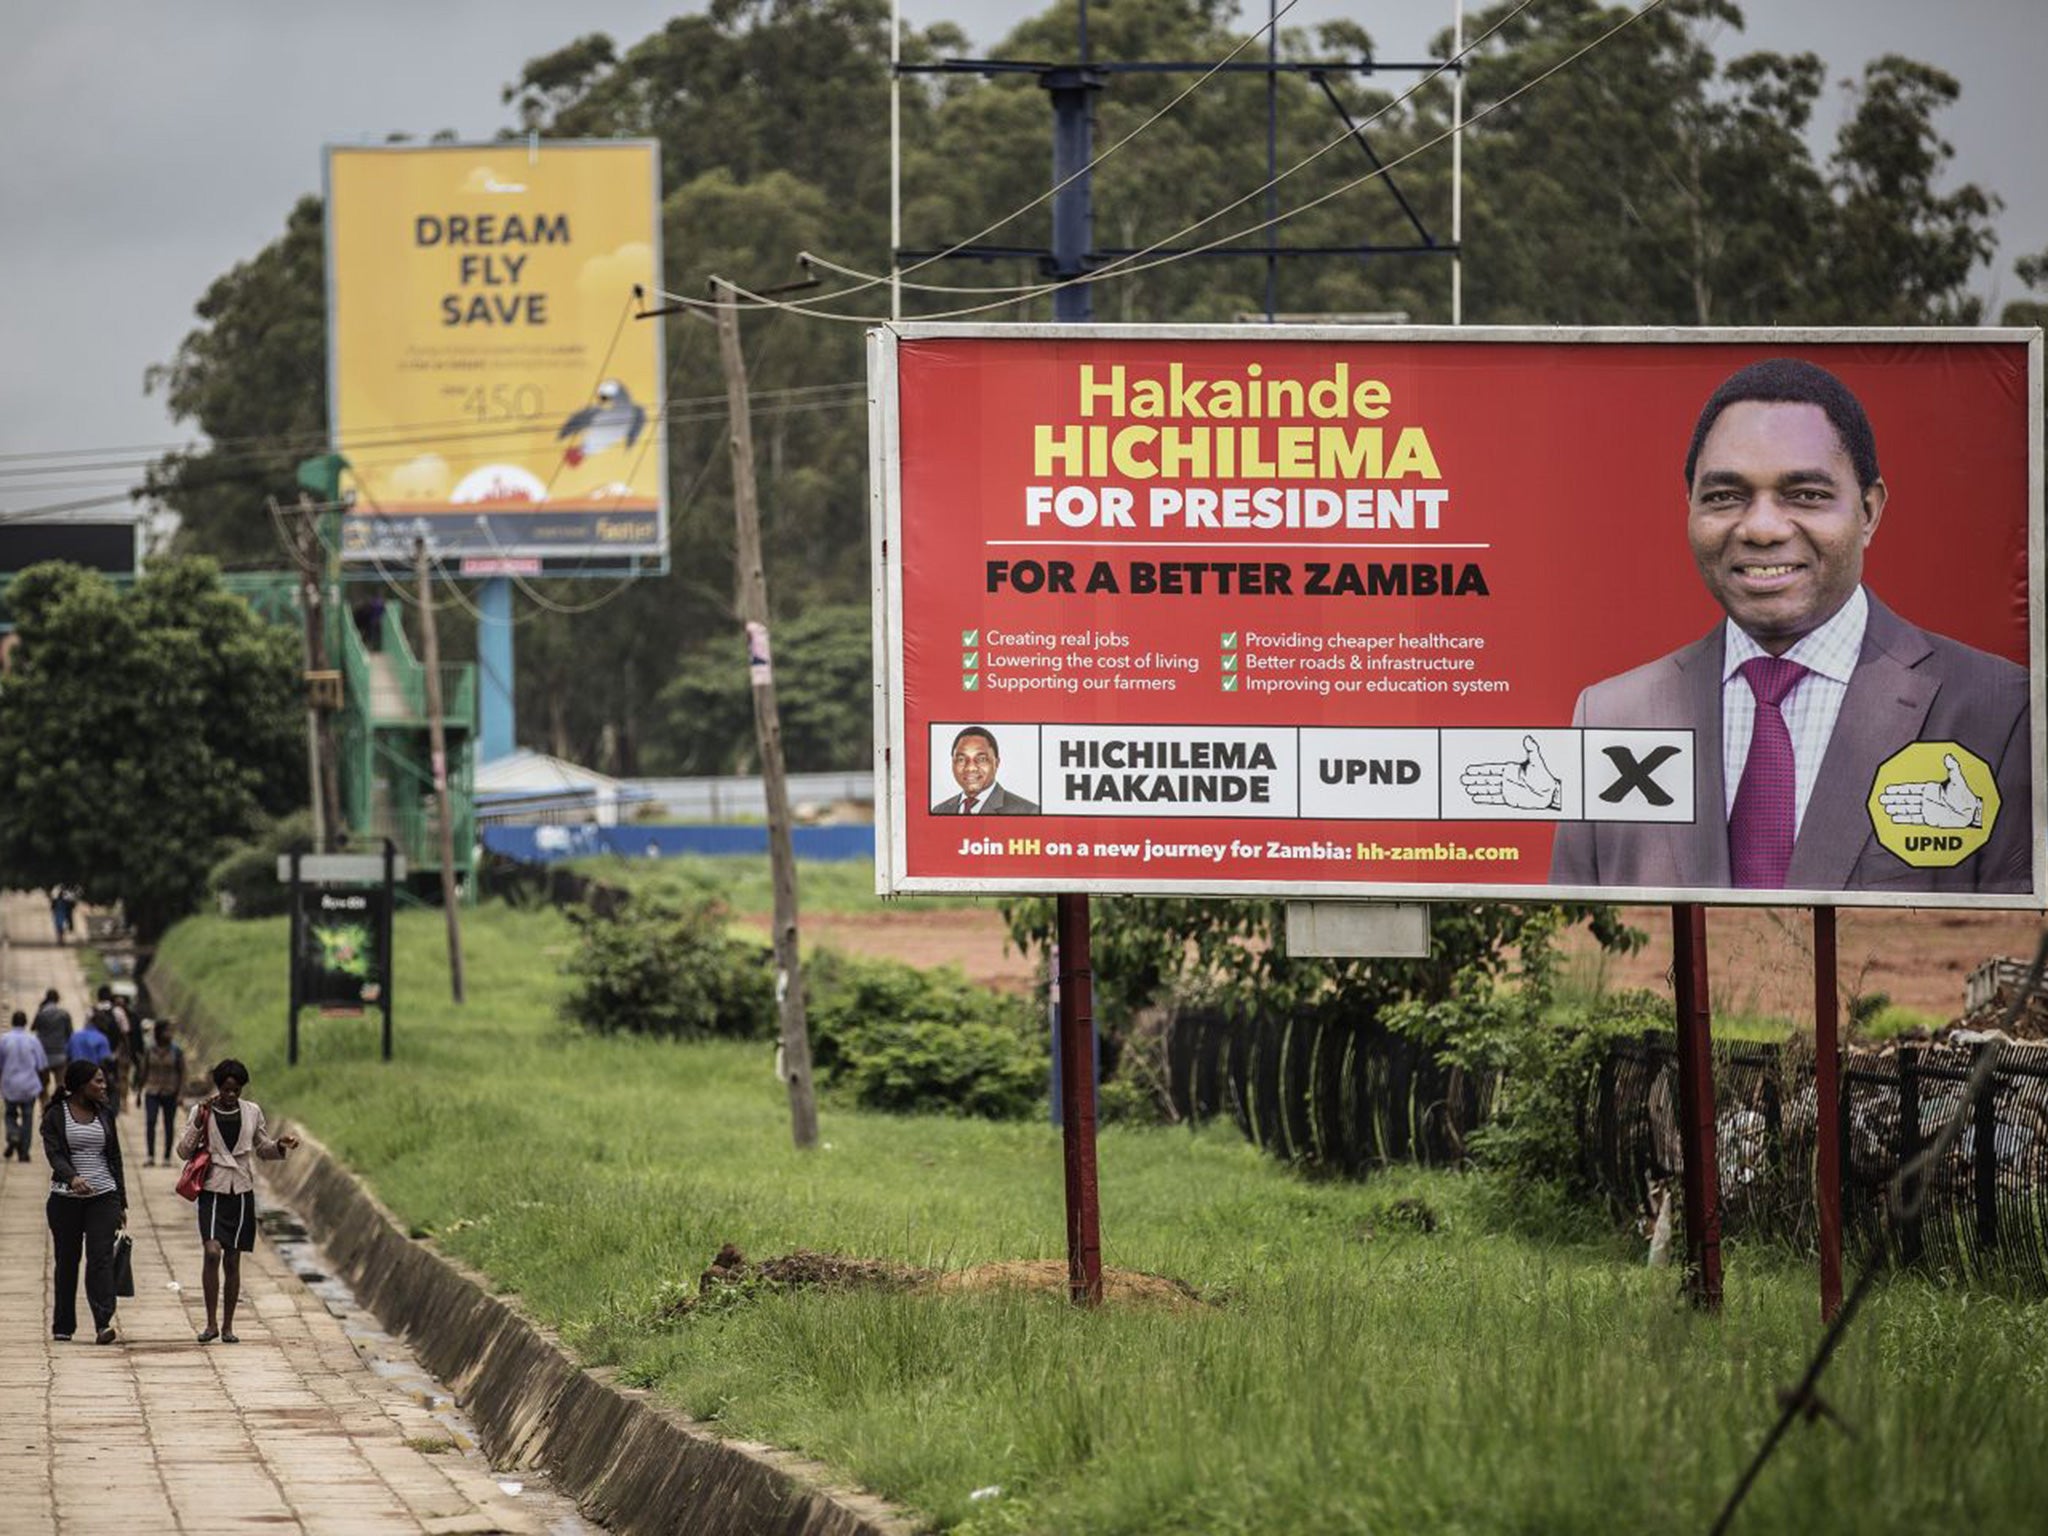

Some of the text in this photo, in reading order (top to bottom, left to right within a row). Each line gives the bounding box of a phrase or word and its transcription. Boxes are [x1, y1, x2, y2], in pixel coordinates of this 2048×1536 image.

[416, 215, 569, 246] DREAM
[461, 255, 526, 285] FLY
[442, 294, 546, 326] SAVE
[1081, 363, 1391, 419] Hakainde
[1035, 425, 1441, 479] HICHILEMA
[1026, 486, 1448, 528] FOR PRESIDENT
[987, 560, 1489, 596] FOR A BETTER ZAMBIA
[987, 630, 1129, 650] Creating real jobs
[1246, 633, 1484, 652] Providing cheaper healthcare
[988, 652, 1199, 672] Lowering the cost of living
[1246, 654, 1474, 670] Better roads & infrastructure
[987, 673, 1176, 693] Supporting our farmers
[1247, 675, 1509, 696] Improving our education system
[1061, 741, 1277, 770] HICHILEMA
[1320, 759, 1421, 784] UPND
[1066, 774, 1269, 803] HAKAINDE
[958, 837, 1518, 862] Join HH on a new journey for Zambia: hh-zambia.com
[1905, 836, 1962, 851] UPND
